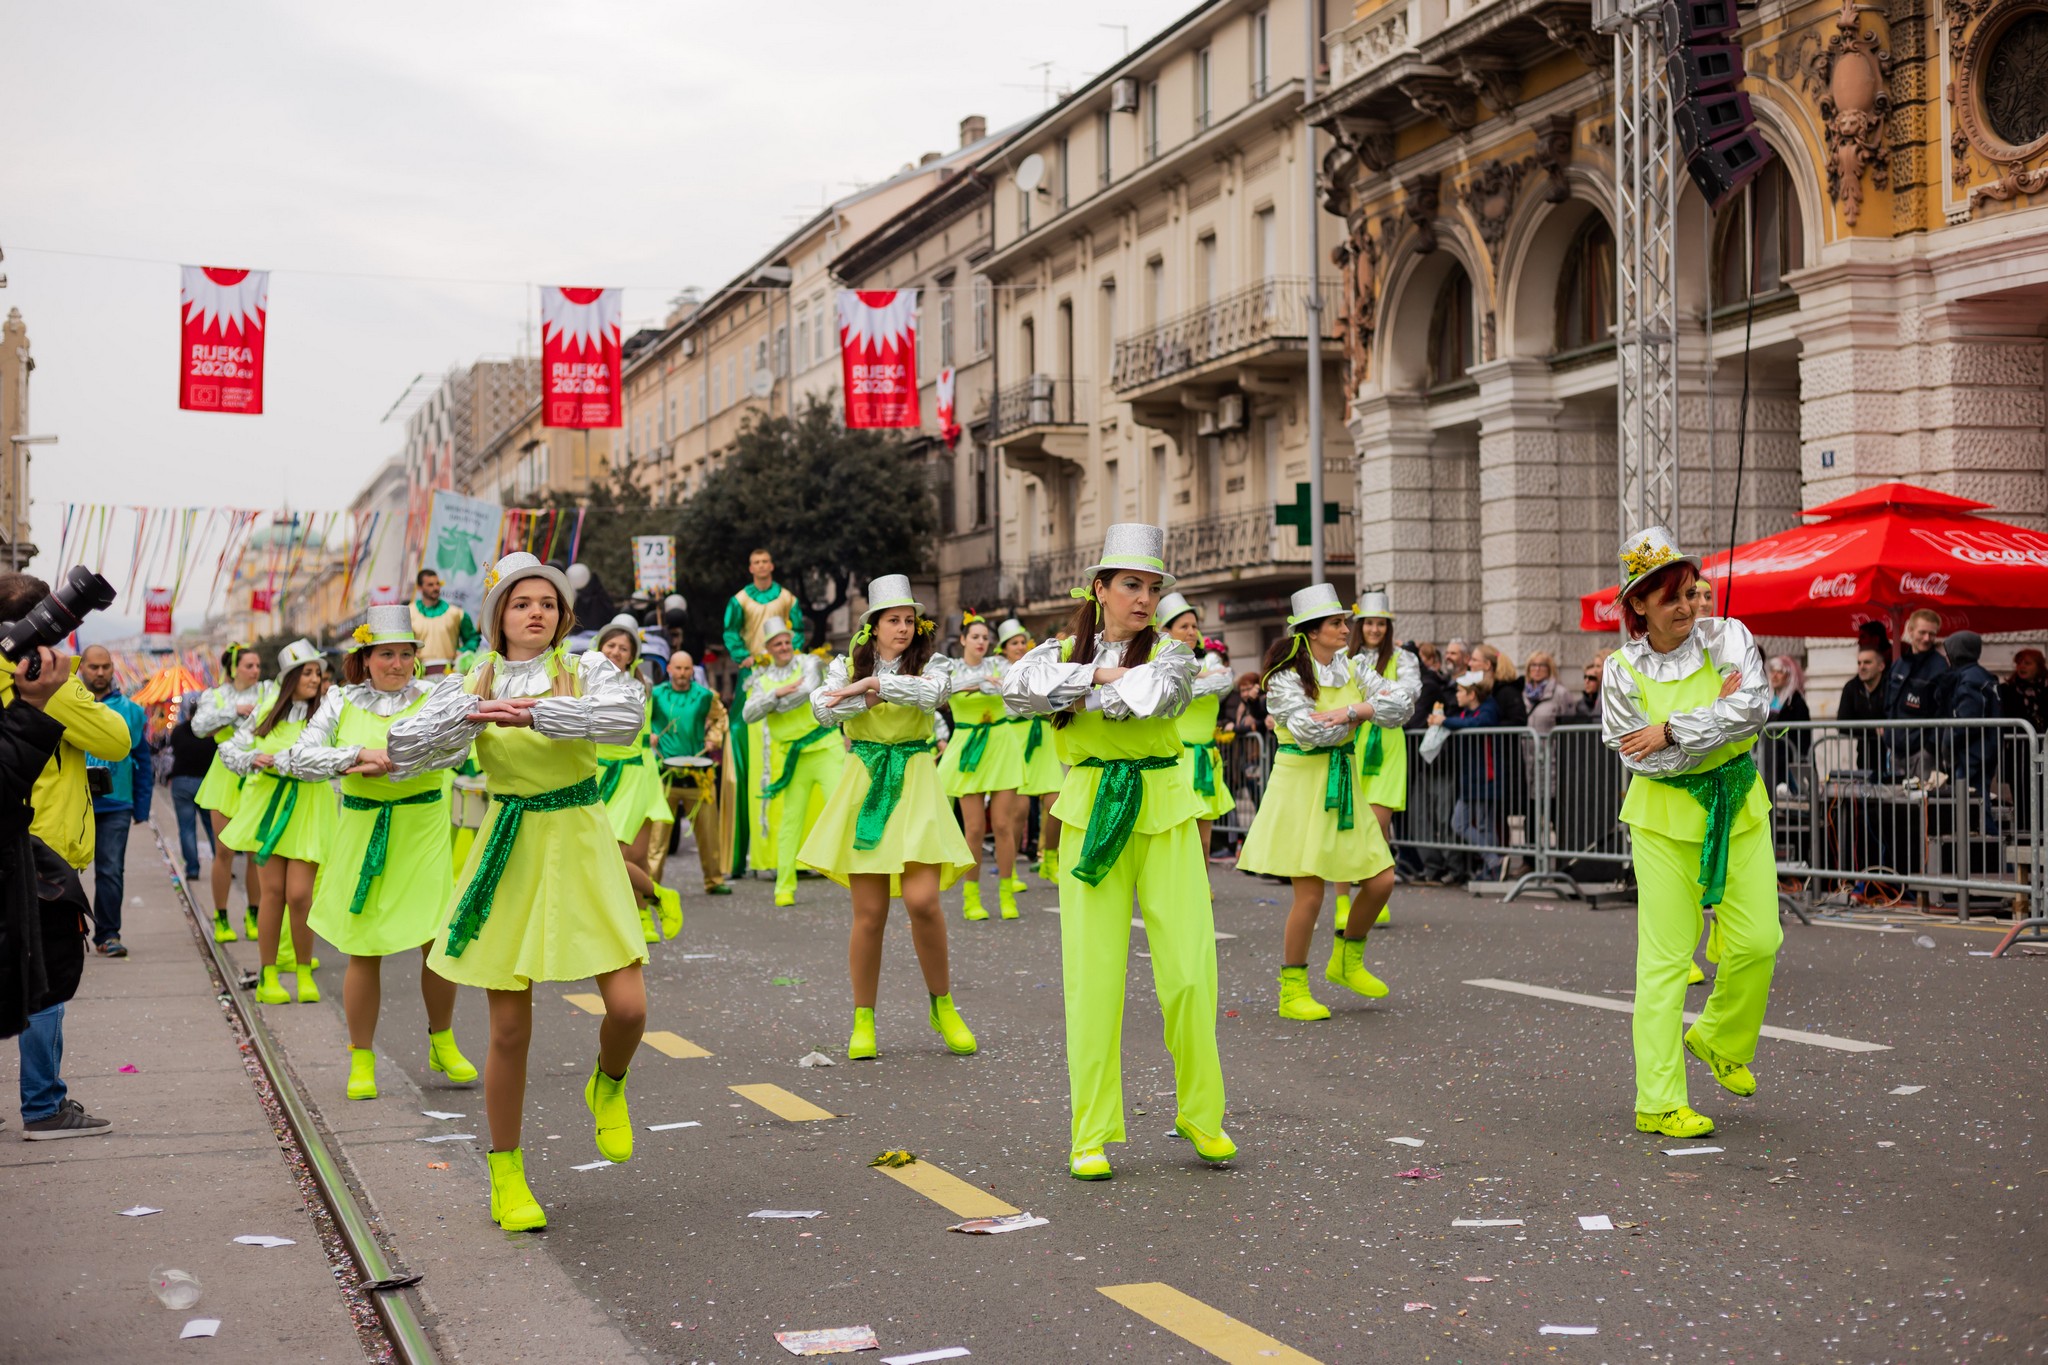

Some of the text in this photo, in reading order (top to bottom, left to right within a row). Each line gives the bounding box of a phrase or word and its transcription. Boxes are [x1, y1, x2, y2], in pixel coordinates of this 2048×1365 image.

[192, 344, 254, 363] RIJEKA
[190, 361, 254, 379] 2020.eu
[552, 362, 610, 378] RIJEKA
[852, 364, 906, 379] RIJEKA
[643, 542, 664, 556] 73
[1809, 572, 1857, 600] Coca-Cola
[1899, 572, 1951, 596] Coca-Cola
